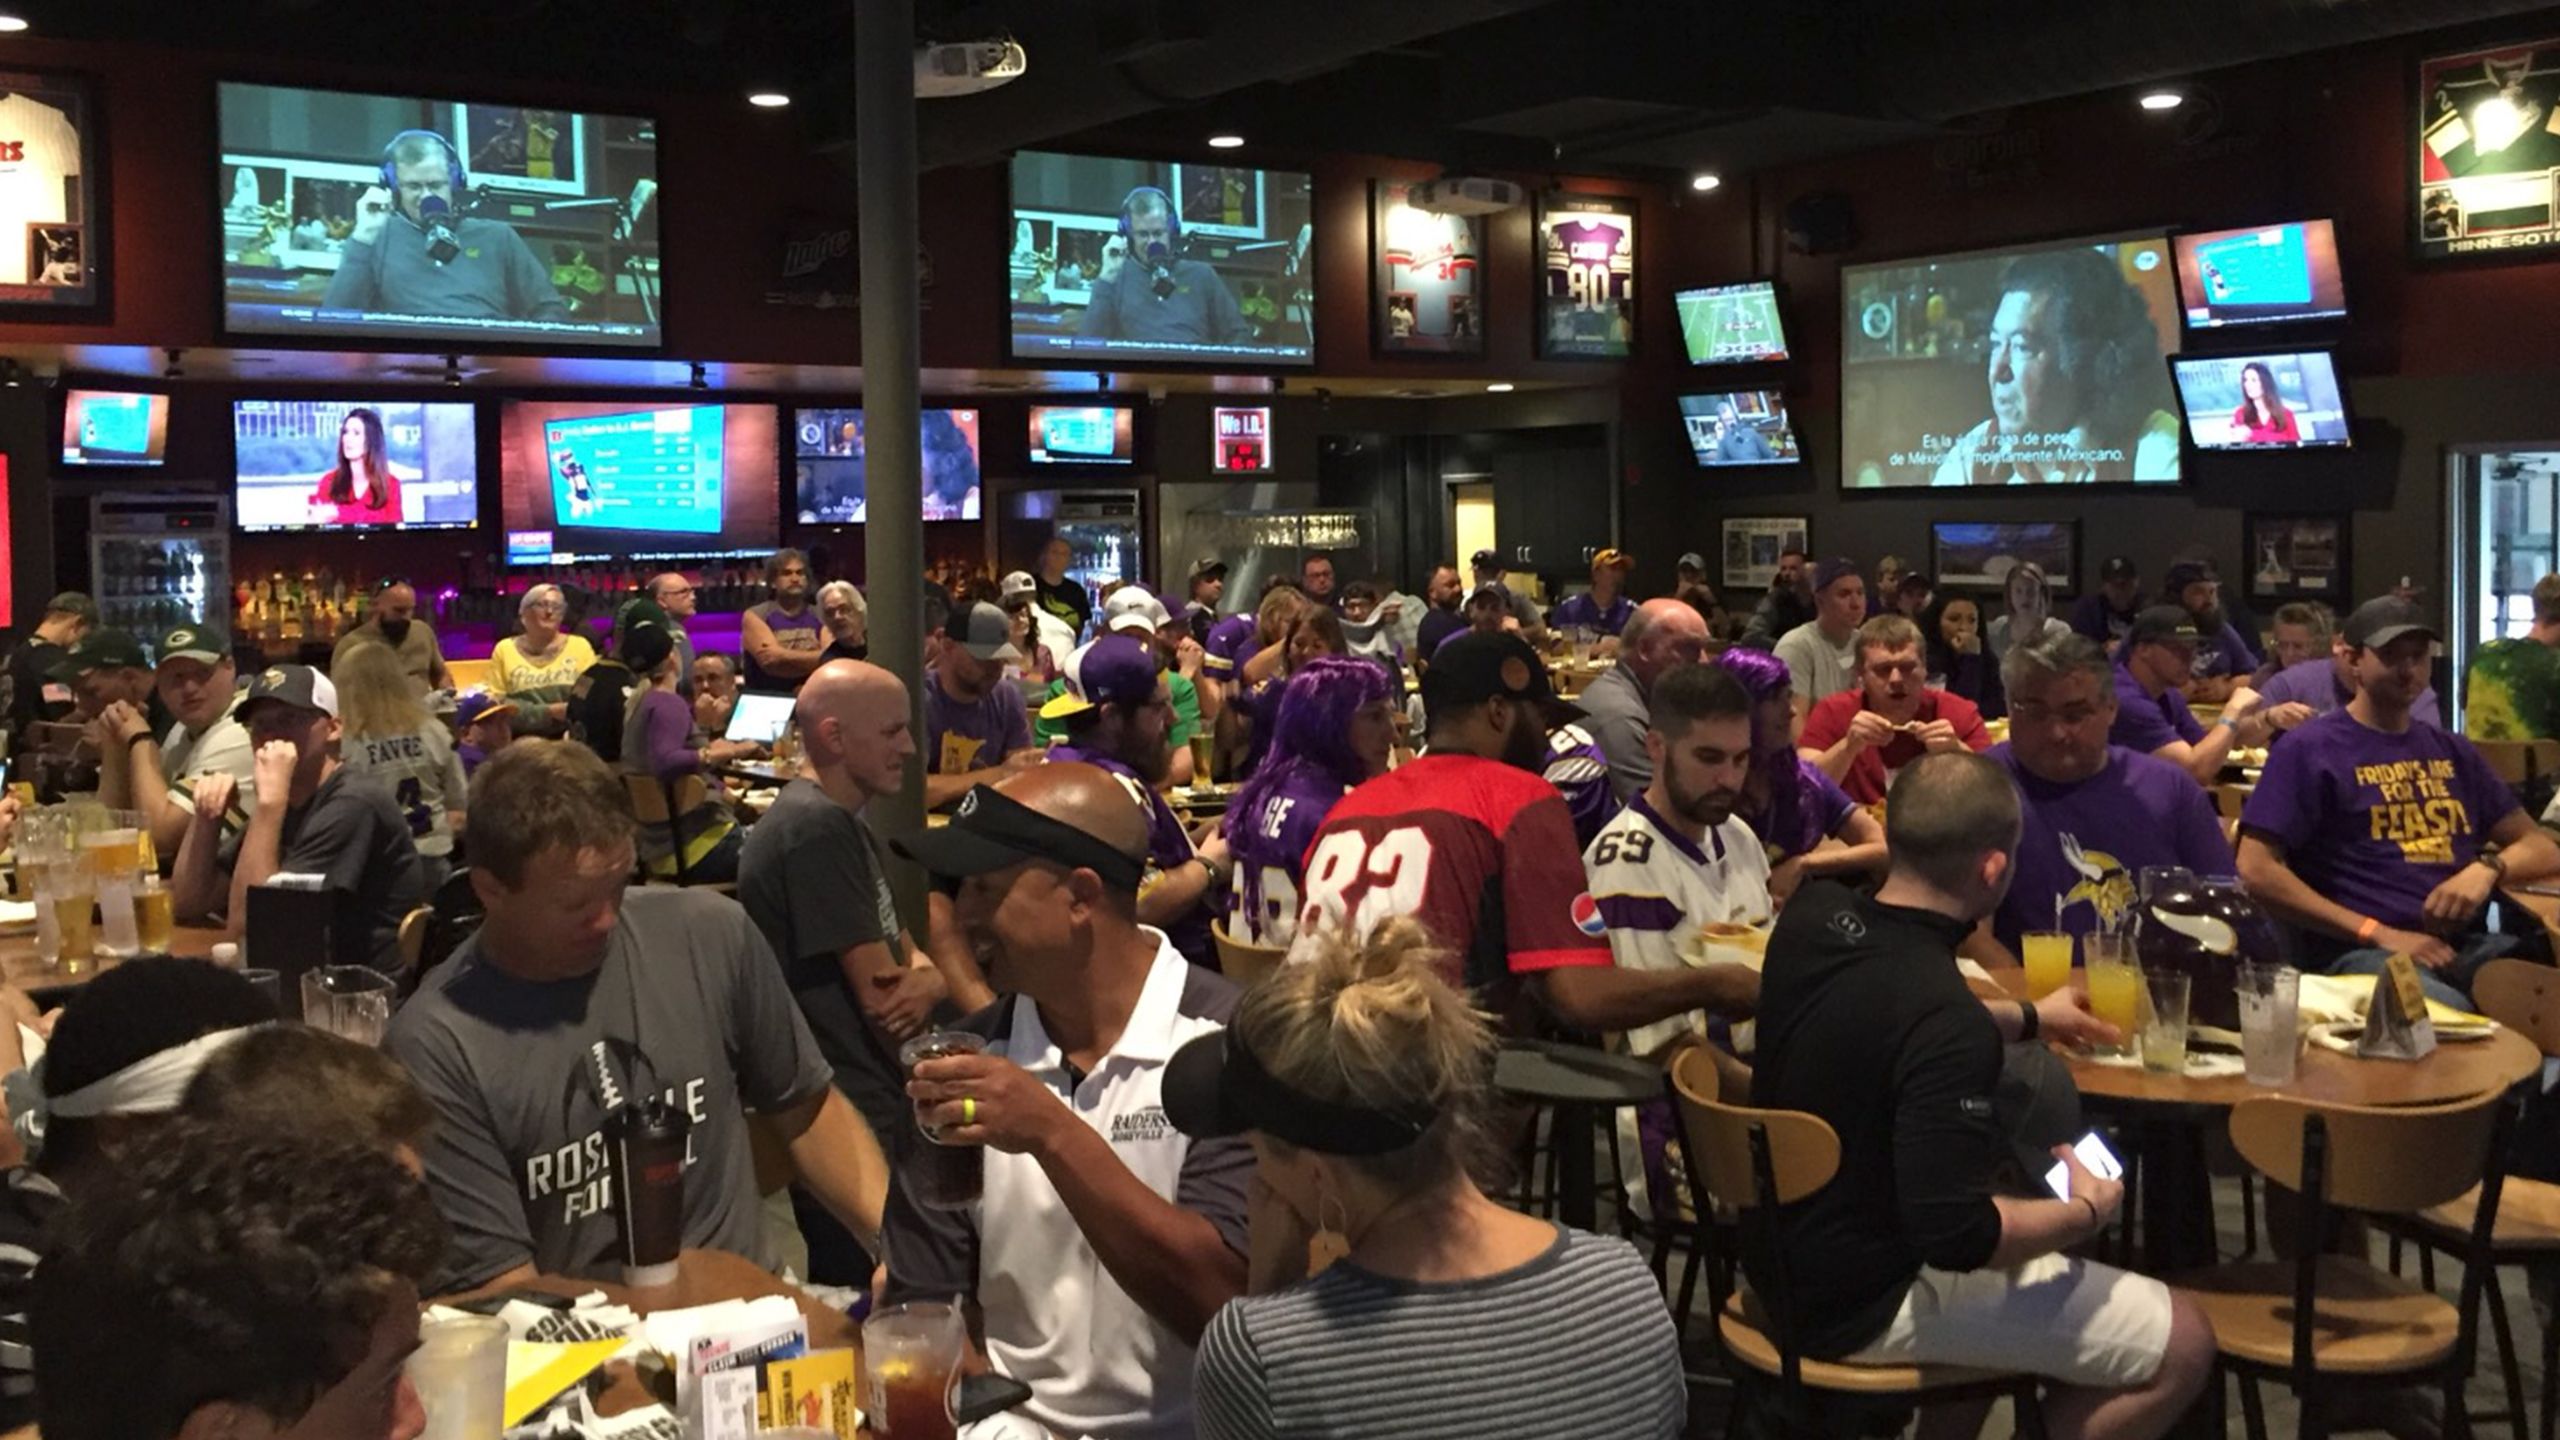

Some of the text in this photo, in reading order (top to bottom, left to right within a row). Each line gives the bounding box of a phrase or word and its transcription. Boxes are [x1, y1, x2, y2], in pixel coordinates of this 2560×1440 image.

[1567, 264, 1610, 313] 80
[1220, 414, 1241, 434] We
[2022, 431, 2040, 446] de
[1889, 452, 1905, 466] de
[2056, 446, 2126, 463] Mexicano.
[366, 737, 422, 765] FAVRE
[2380, 779, 2450, 802] FOR THE
[395, 776, 434, 837] 4
[1594, 829, 1655, 867] 69
